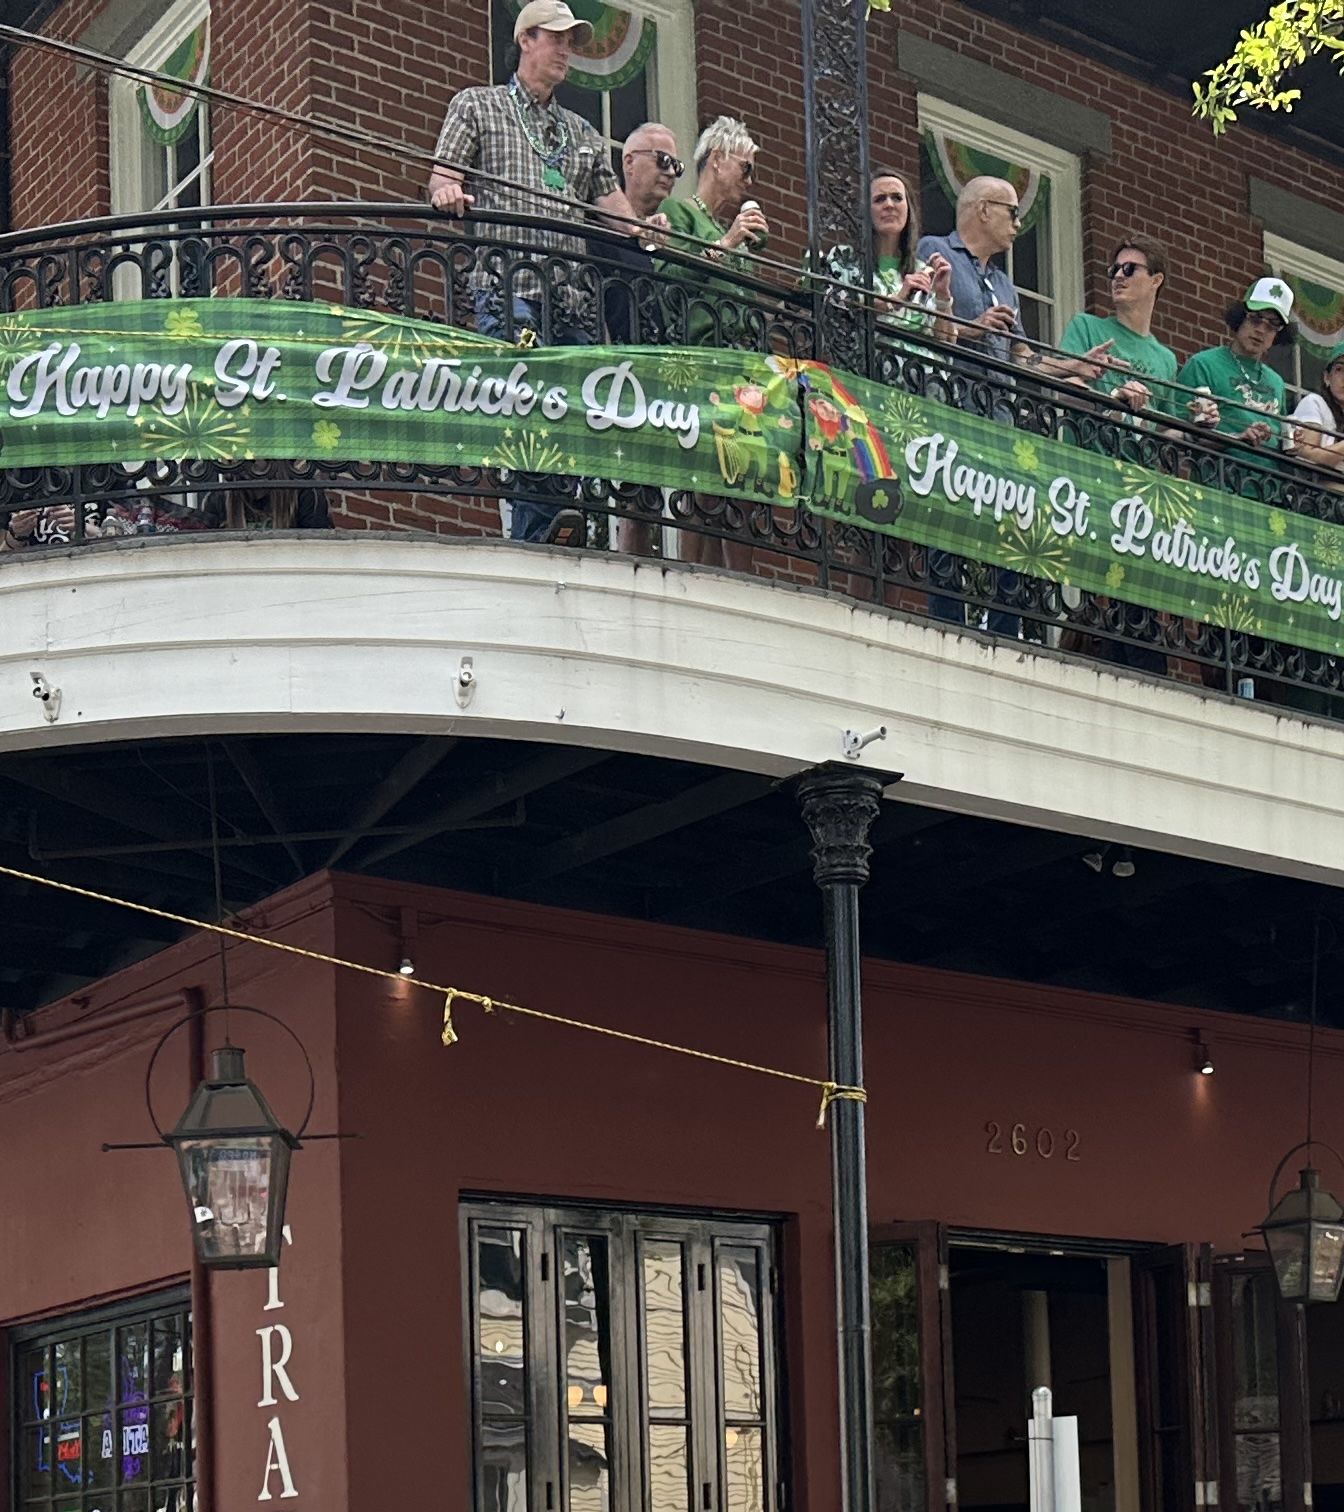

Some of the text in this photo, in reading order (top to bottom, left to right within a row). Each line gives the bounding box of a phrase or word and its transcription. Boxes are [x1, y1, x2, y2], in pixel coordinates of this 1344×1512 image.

[7, 337, 701, 448] Happy St. Patrick's Day
[905, 431, 1343, 621] Happy St. Patrick's Day
[984, 1119, 1081, 1162] 2602
